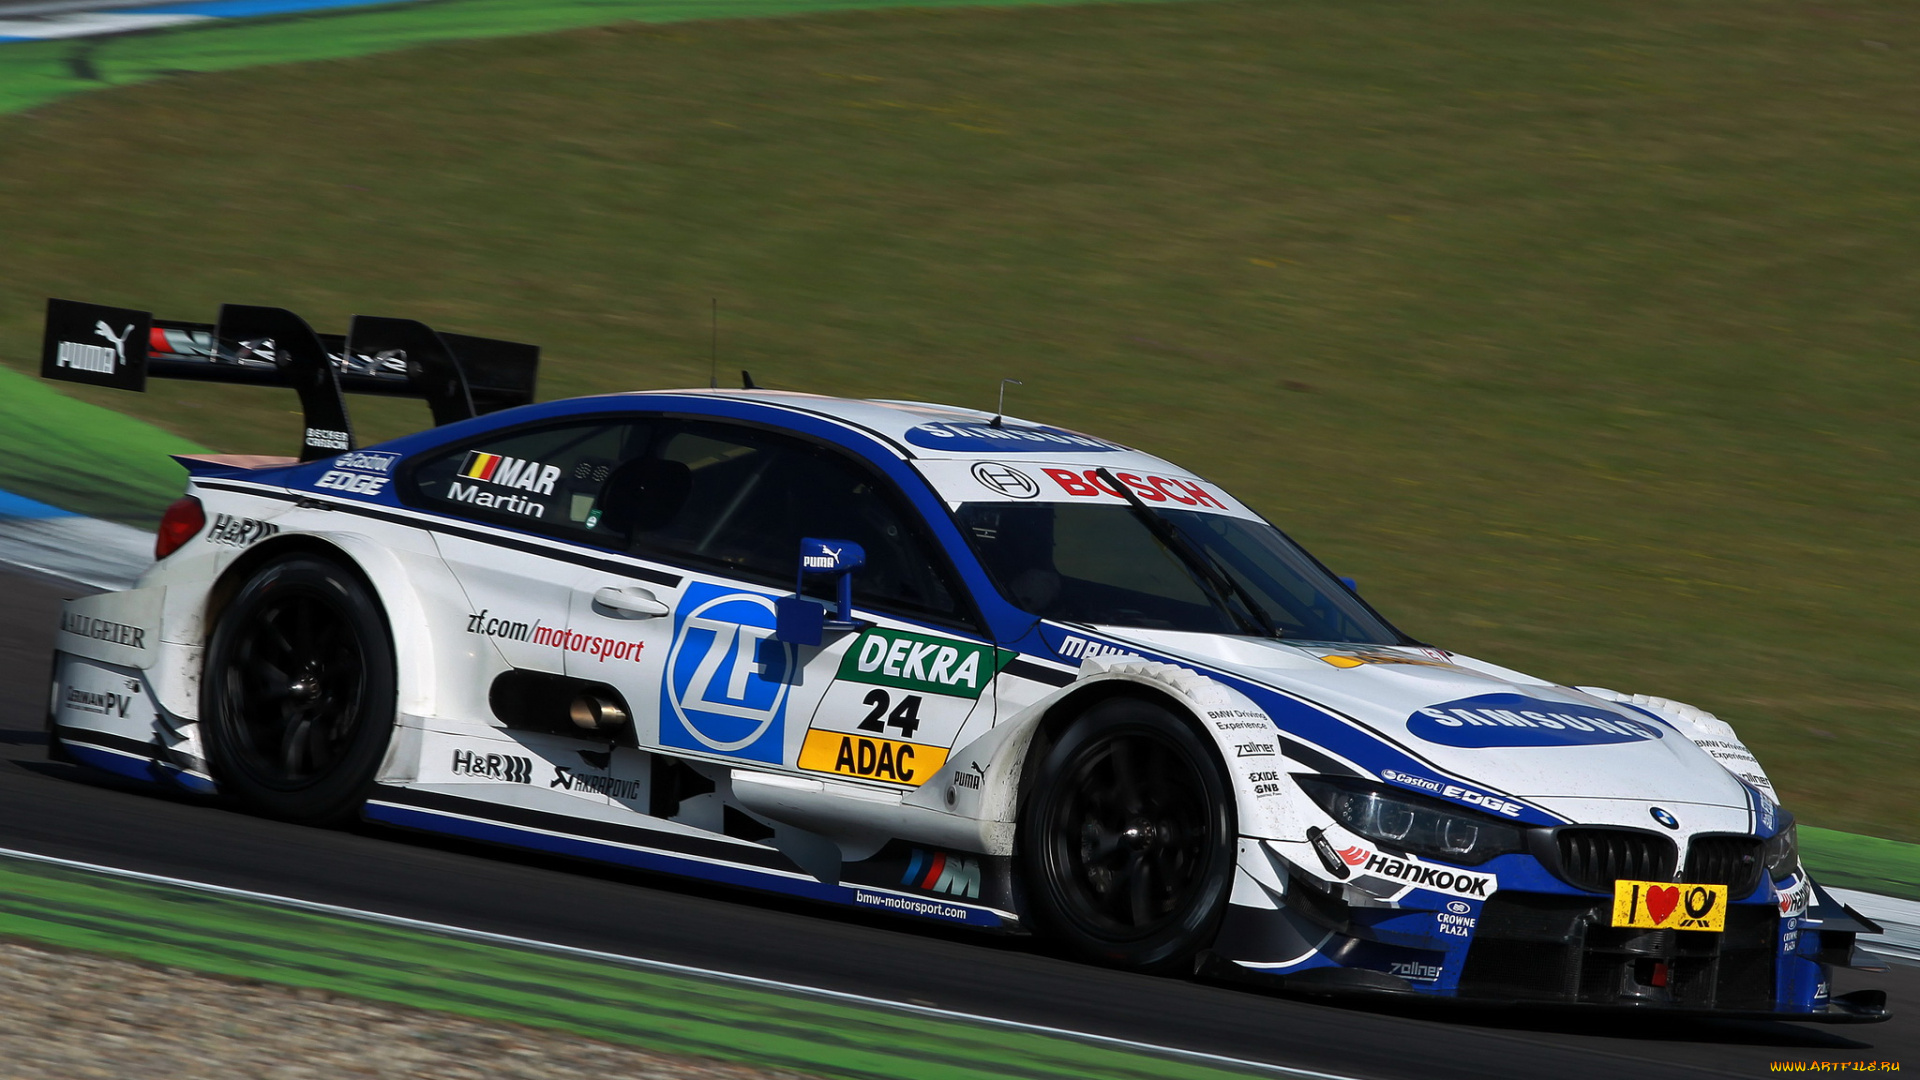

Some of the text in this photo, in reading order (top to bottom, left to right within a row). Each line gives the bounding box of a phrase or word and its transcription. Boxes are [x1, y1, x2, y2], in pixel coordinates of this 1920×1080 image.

[56, 341, 116, 375] PUMA
[915, 424, 1130, 451] SAMSUN
[314, 470, 391, 496] EDGE
[492, 456, 561, 496] MAR
[1040, 467, 1229, 511] BOSCH
[447, 481, 545, 519] Martin
[803, 556, 835, 569] PUMA
[679, 615, 782, 723] ZF
[857, 634, 981, 689] DEKRA
[856, 688, 923, 739] 24
[1207, 710, 1268, 721] BMW Driving
[1215, 721, 1268, 731] Experience
[1418, 707, 1655, 740] SAMSUNG
[452, 749, 502, 778] H&R
[834, 736, 915, 782] ADAC
[954, 771, 980, 790] PUMA
[1249, 771, 1280, 783] EXIDE
[1254, 783, 1280, 794] GNB
[1396, 772, 1524, 818] Castrol EDGE
[856, 889, 967, 920] bmw-motorsport.com
[1436, 912, 1476, 928] CROWNE
[1439, 923, 1468, 937] PLAZA
